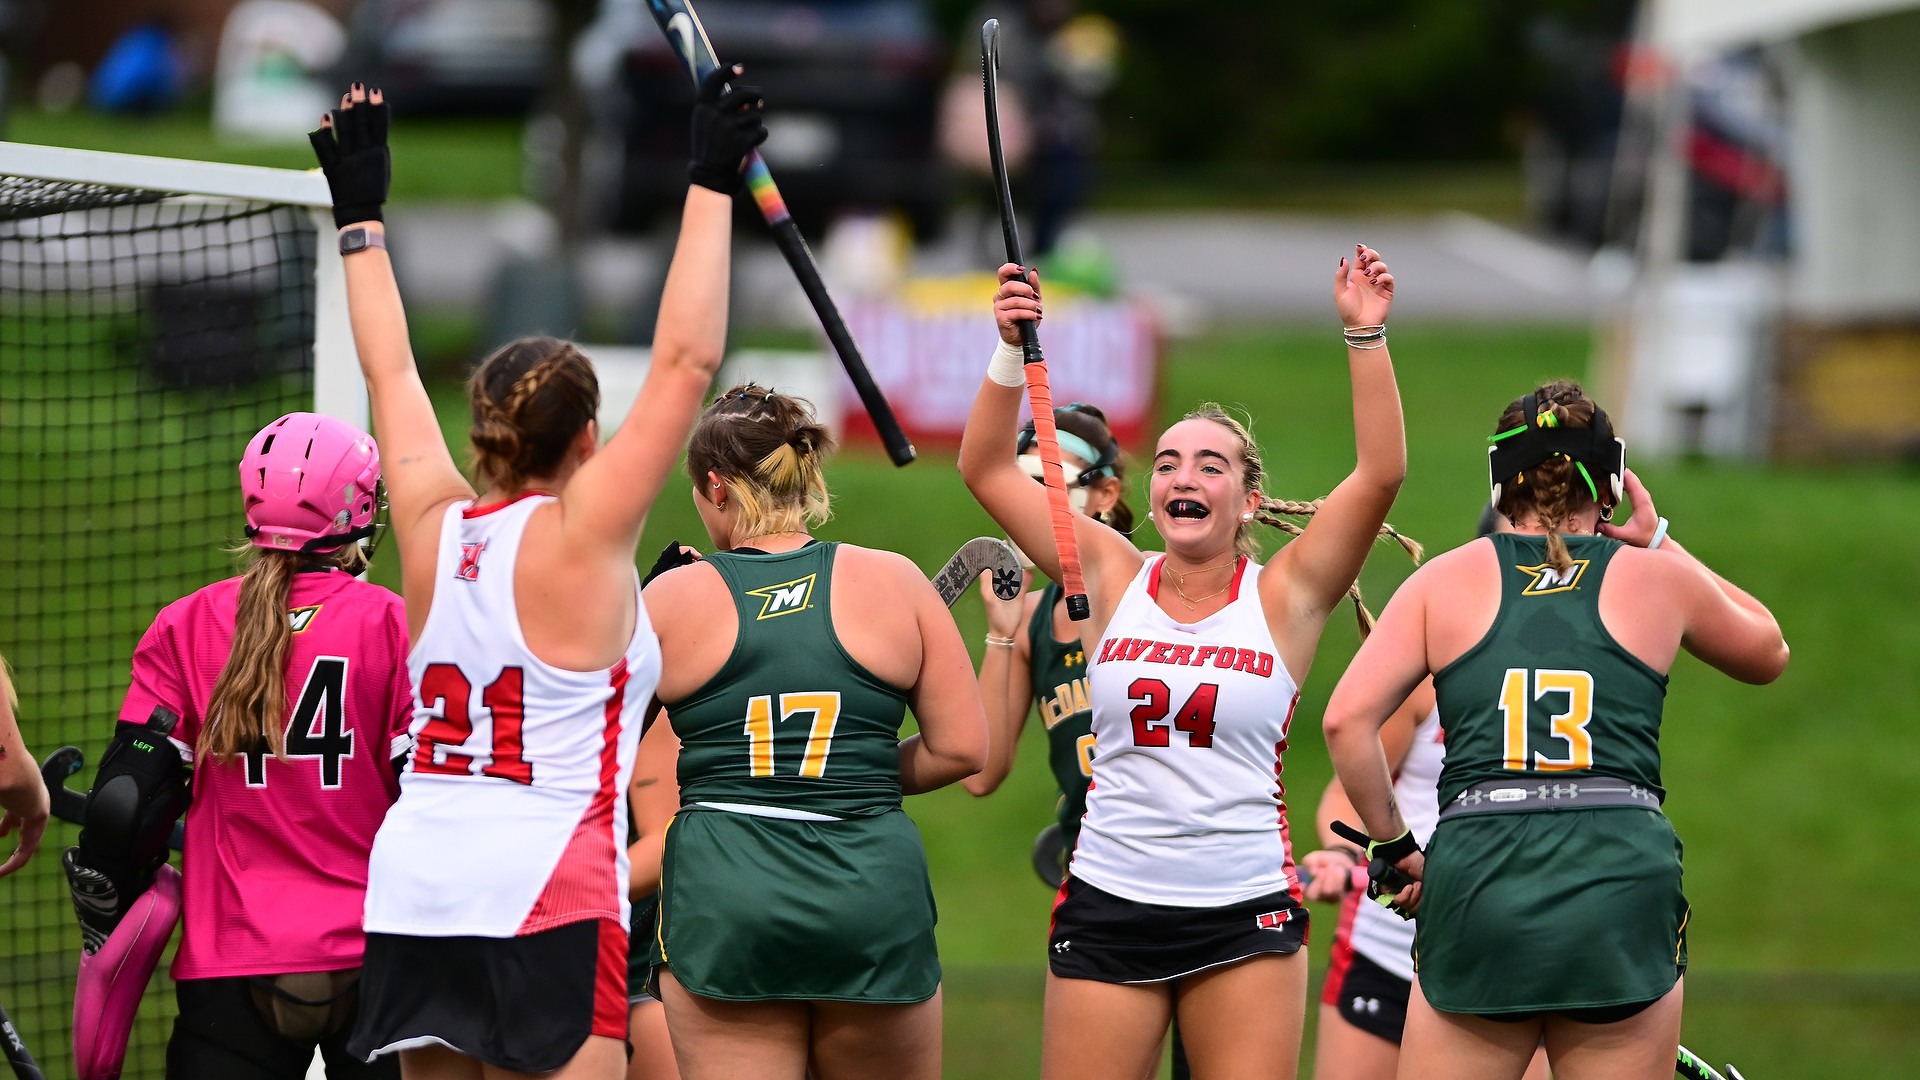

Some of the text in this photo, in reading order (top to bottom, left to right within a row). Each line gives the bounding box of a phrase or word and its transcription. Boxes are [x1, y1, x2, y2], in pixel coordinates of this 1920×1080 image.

[1178, 502, 1187, 512] H
[1096, 637, 1274, 678] HAVERFORD
[133, 739, 155, 753] LEFT
[412, 662, 533, 786] 21
[743, 691, 842, 778] 17
[1127, 677, 1220, 748] 24
[1498, 668, 1595, 771] 13
